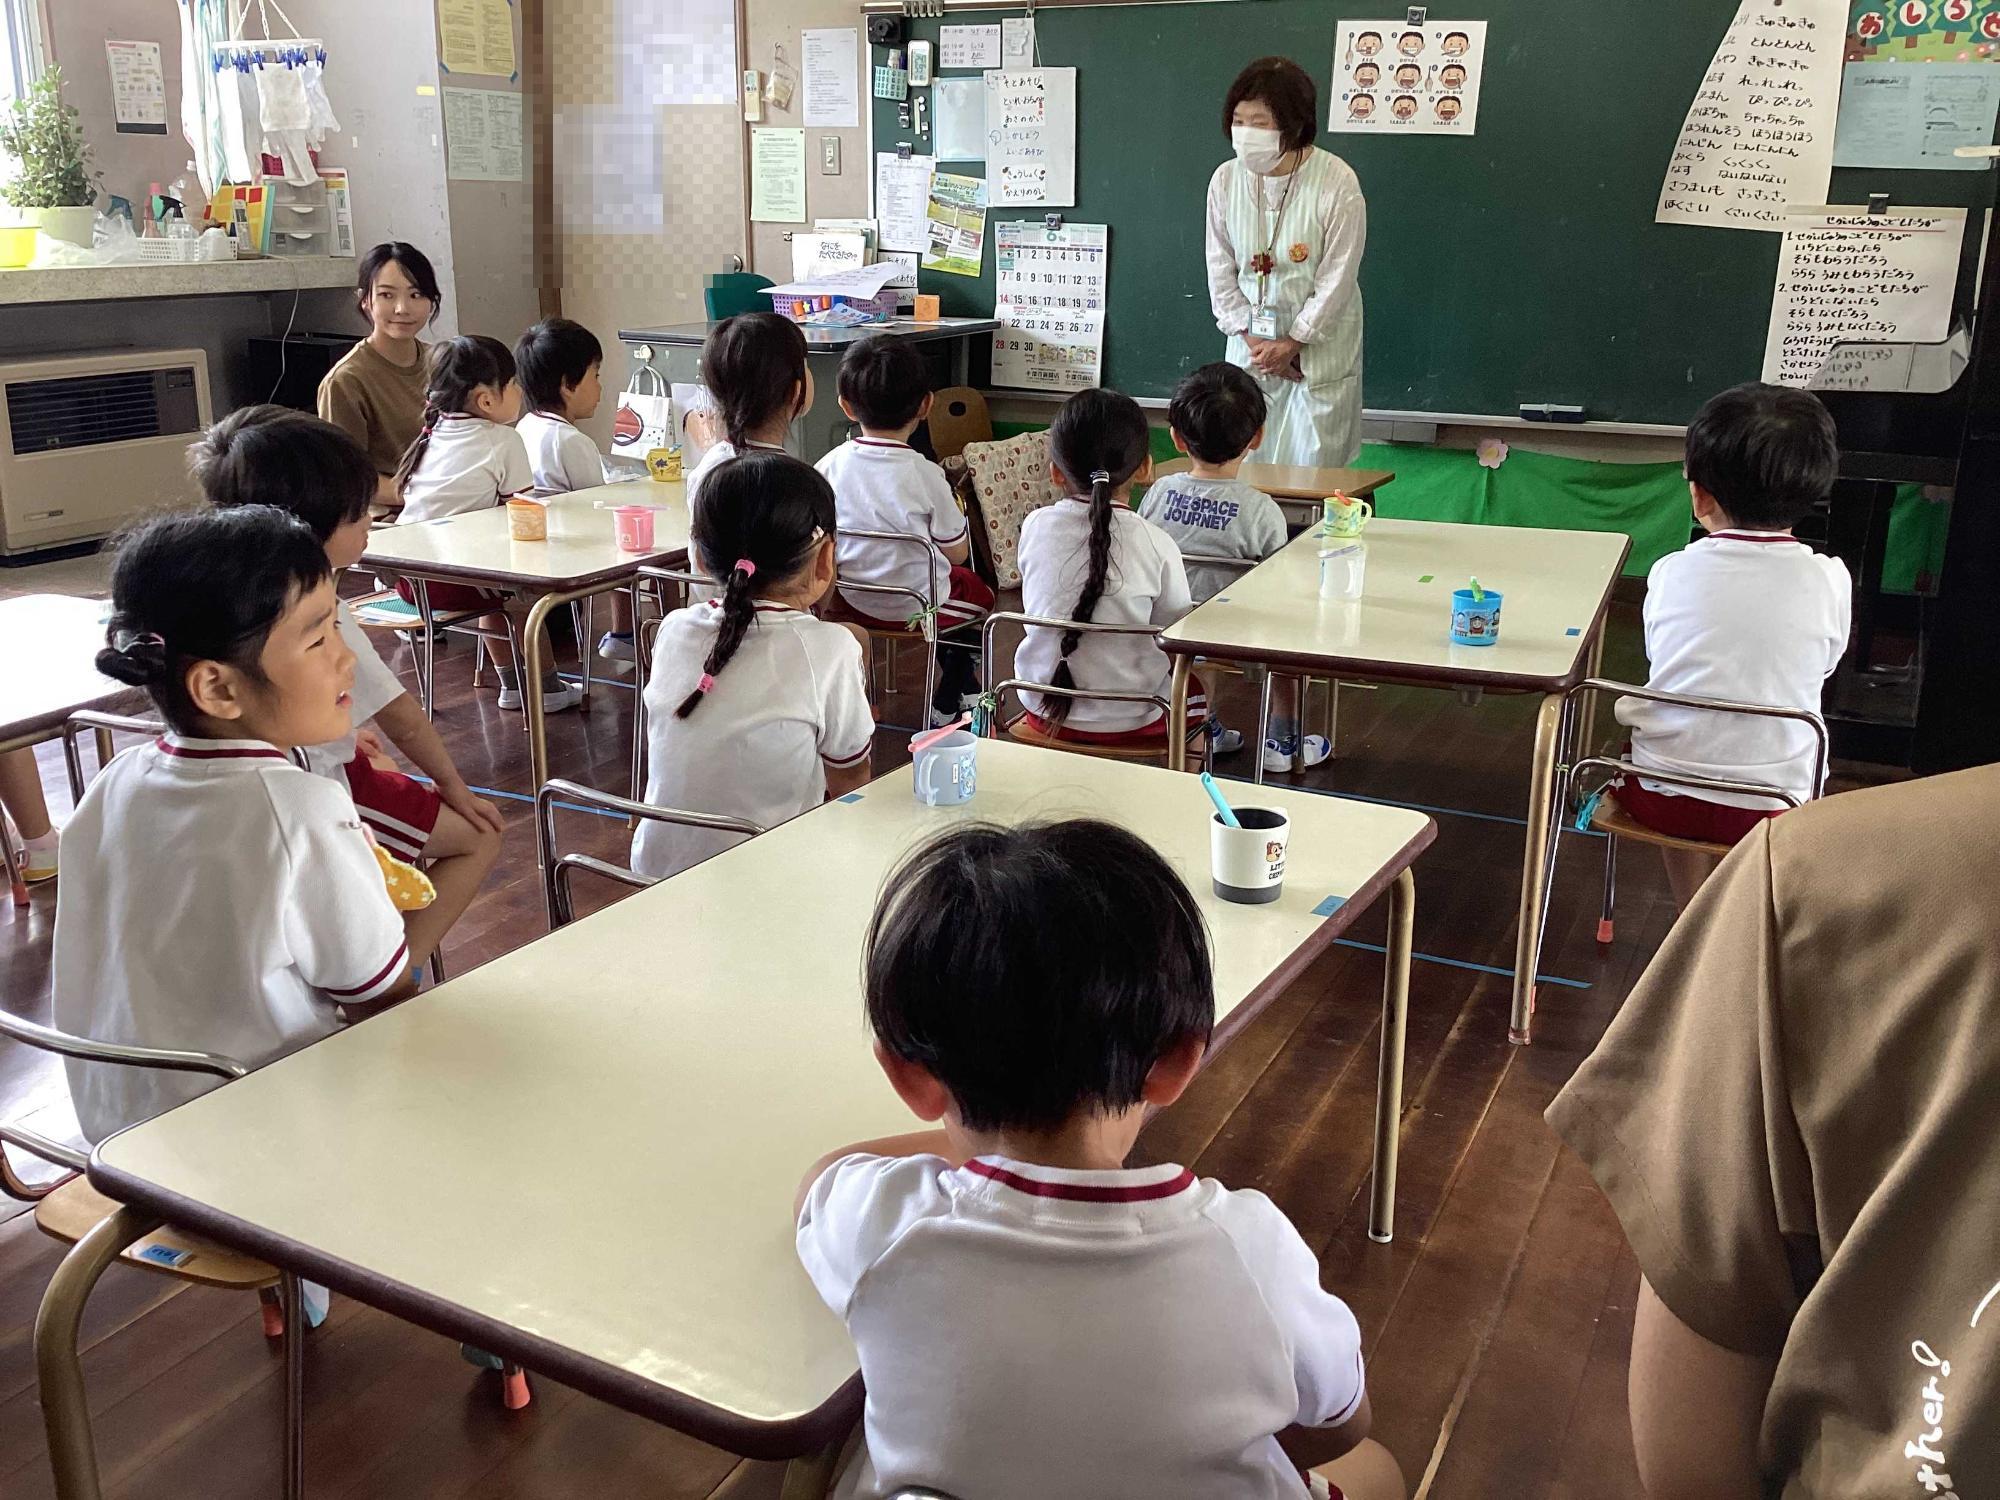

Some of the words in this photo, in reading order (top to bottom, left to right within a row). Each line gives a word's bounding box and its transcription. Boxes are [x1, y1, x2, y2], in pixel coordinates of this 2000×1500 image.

[1750, 37, 1816, 53] とんとんとん
[1685, 123, 1741, 137] ほうれんそう
[1752, 128, 1813, 143] ほうほうほう
[1679, 138, 1722, 150] にんじん
[1733, 142, 1799, 158] にんにんにん
[1674, 152, 1705, 161] おくら
[1671, 165, 1692, 175] なす
[1719, 170, 1787, 185] ないないない
[1668, 180, 1725, 196] さつまいも
[1047, 231, 1057, 241] 6
[1017, 250, 1021, 258] 1
[1032, 250, 1036, 259] 2
[1046, 251, 1051, 260] 3
[1061, 252, 1066, 260] 4
[1076, 253, 1080, 261] 5
[1090, 253, 1095, 262] 6
[1793, 254, 1888, 266] そらもわらうだろう
[1002, 272, 1007, 280] 7
[1016, 272, 1021, 281] 8
[1031, 273, 1036, 282] 9
[1043, 274, 1052, 283] 10
[1058, 275, 1066, 284] 11
[1073, 276, 1081, 284] 12
[1088, 276, 1096, 285] 13
[1000, 294, 1008, 303] 14
[1014, 295, 1022, 304] 15
[1028, 296, 1037, 305] 16
[1043, 297, 1051, 305] 17
[1057, 298, 1066, 307] 18
[1072, 299, 1080, 308] 19
[1087, 299, 1096, 308] 20
[1790, 296, 1880, 306] いちどにないたら
[1788, 308, 1869, 320] そらもなくだろう
[998, 318, 1005, 327] 1
[1011, 319, 1020, 328] 22
[1026, 320, 1035, 328] 23
[1040, 321, 1049, 330] 24
[1055, 322, 1064, 331] 25
[1069, 323, 1079, 332] 26
[1084, 324, 1094, 332] 27
[995, 340, 1004, 350] 28
[1010, 341, 1019, 350] 29
[1024, 342, 1033, 351] 30
[1166, 490, 1192, 509] THE
[1190, 496, 1240, 517] SPACE
[1164, 507, 1232, 531] JOURNEY
